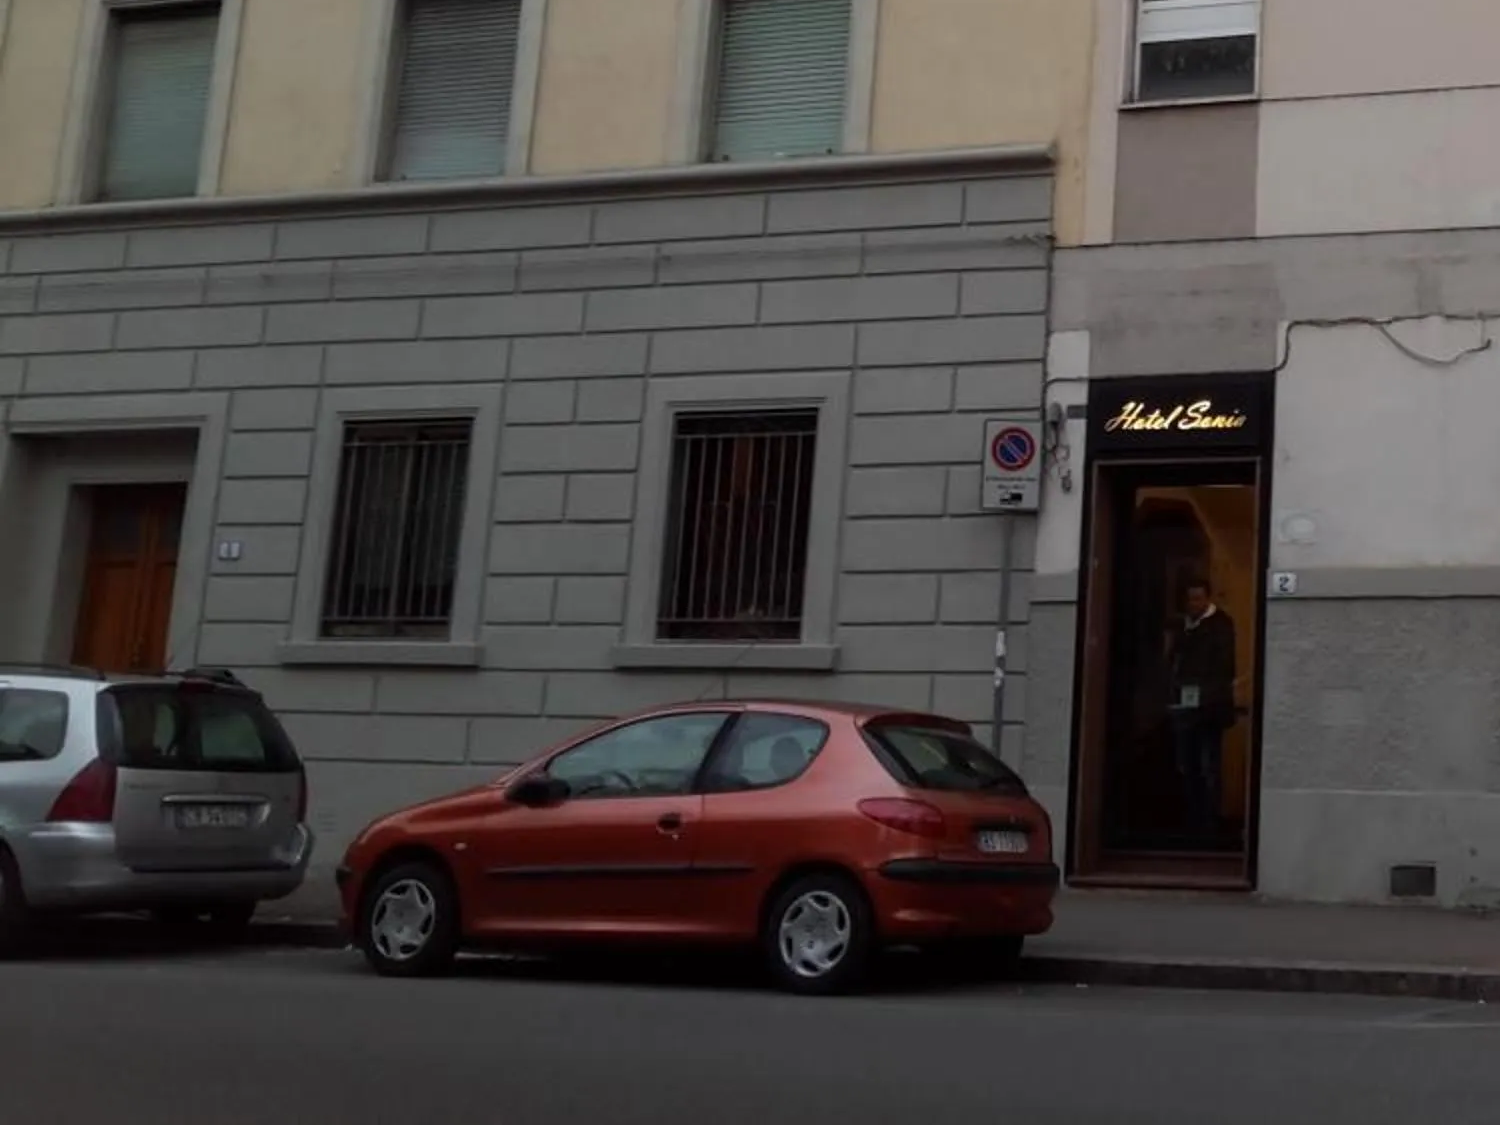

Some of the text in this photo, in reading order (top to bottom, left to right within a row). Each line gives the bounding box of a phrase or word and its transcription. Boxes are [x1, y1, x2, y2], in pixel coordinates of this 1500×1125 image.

[1105, 400, 1247, 432] Hotel Sonia
[1279, 576, 1290, 592] 2
